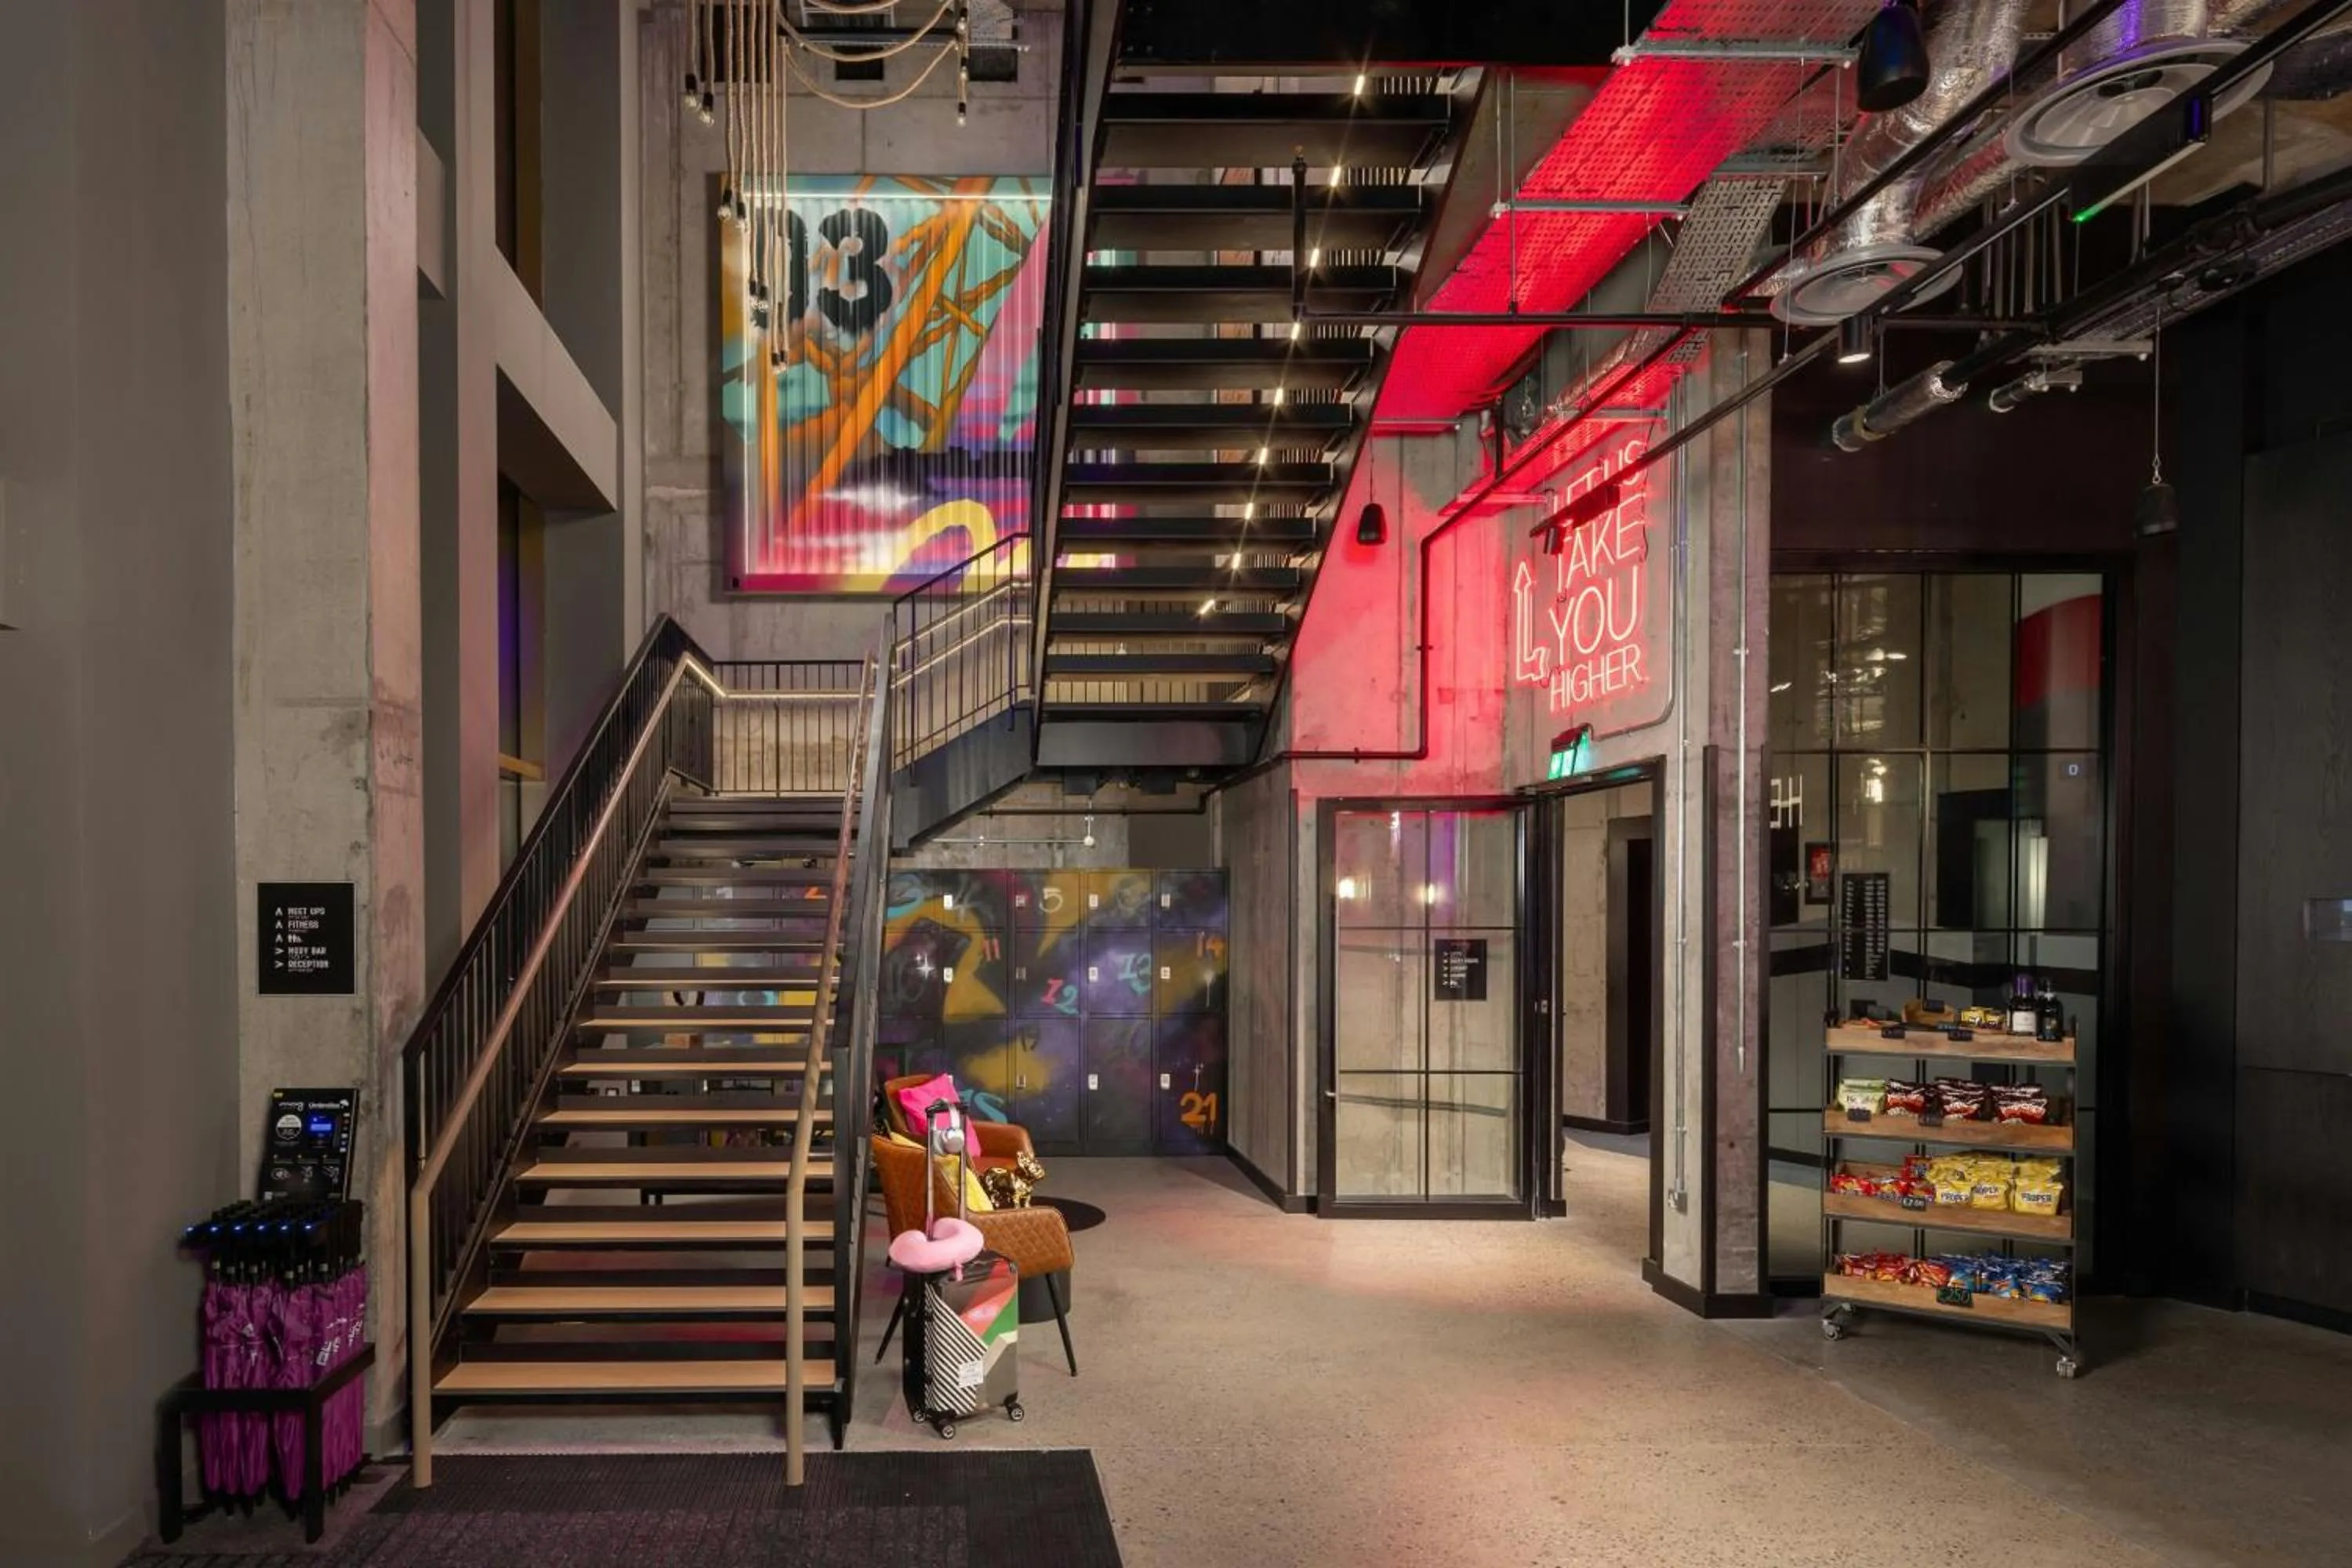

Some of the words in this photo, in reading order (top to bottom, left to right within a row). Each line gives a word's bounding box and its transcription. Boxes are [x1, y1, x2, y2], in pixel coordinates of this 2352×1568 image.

[1557, 492, 1646, 593] TAKE
[1548, 564, 1638, 666] YOU
[1550, 644, 1642, 712] HIGHER
[1040, 887, 1063, 913] 5
[288, 920, 319, 929] FITNESS
[1039, 978, 1079, 1014] 12
[1180, 1091, 1218, 1129] 21
